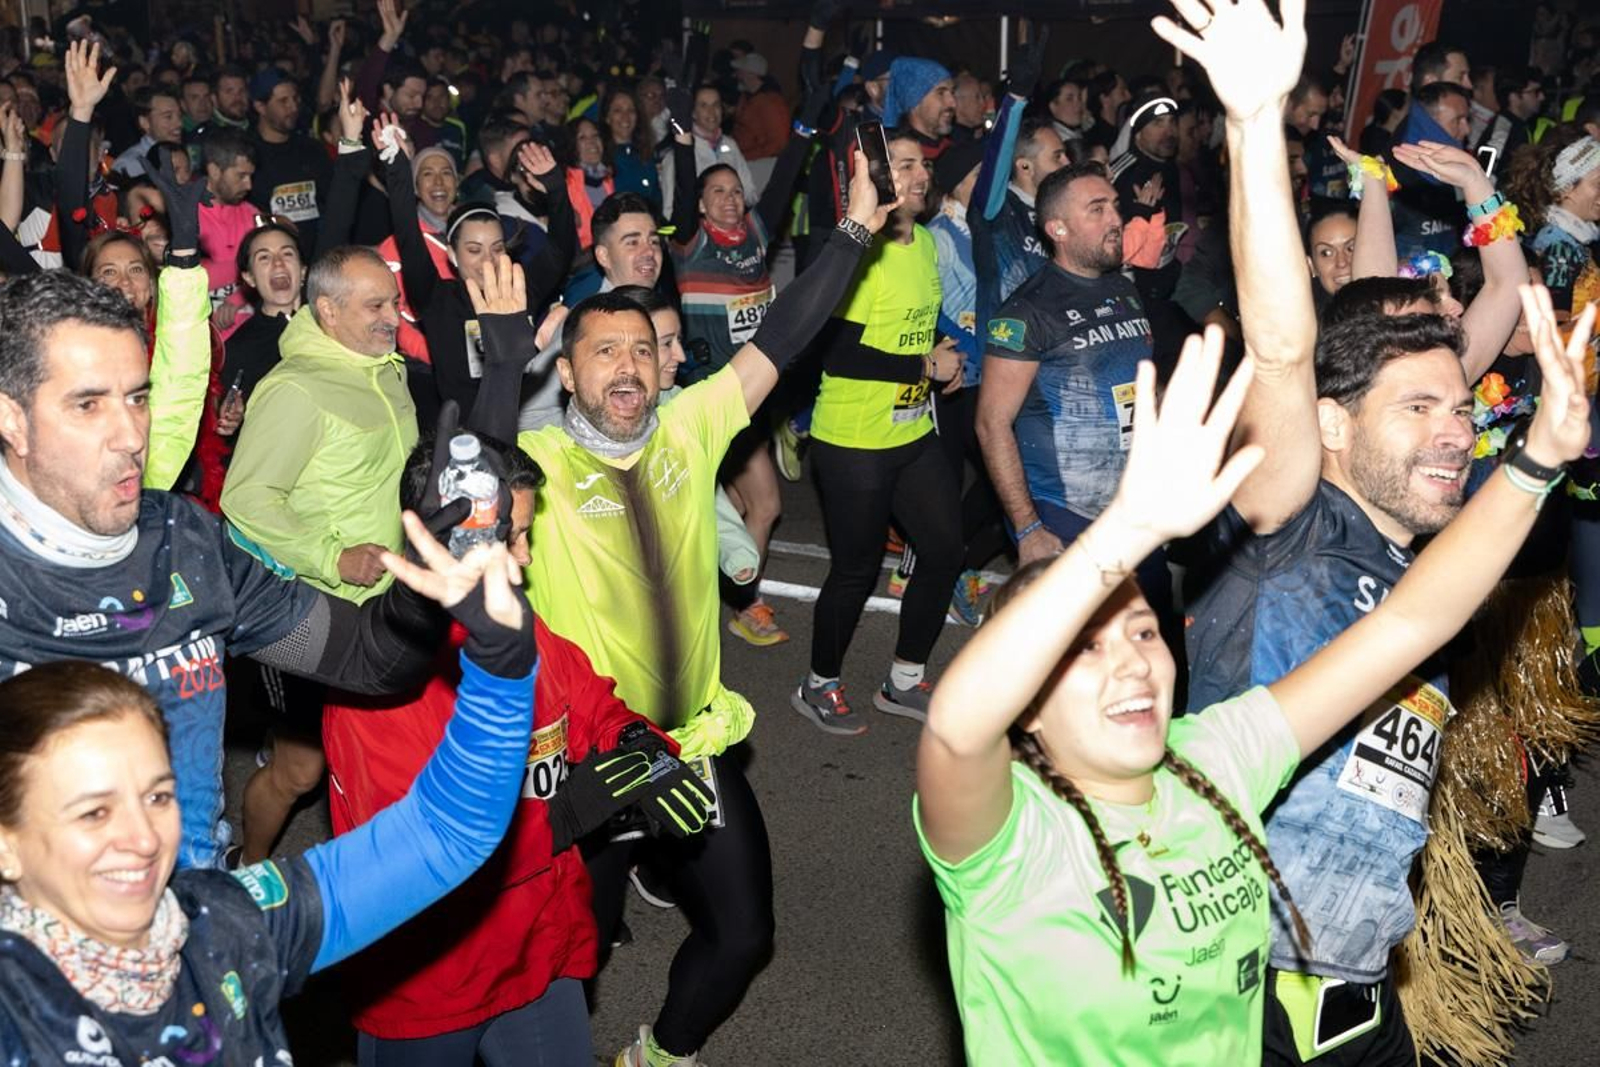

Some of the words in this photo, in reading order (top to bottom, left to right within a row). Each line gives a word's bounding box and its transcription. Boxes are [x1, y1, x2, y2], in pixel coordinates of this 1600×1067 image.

[1072, 324, 1115, 349] SAN
[1373, 706, 1443, 773] 464
[1172, 877, 1263, 933] Unicaja
